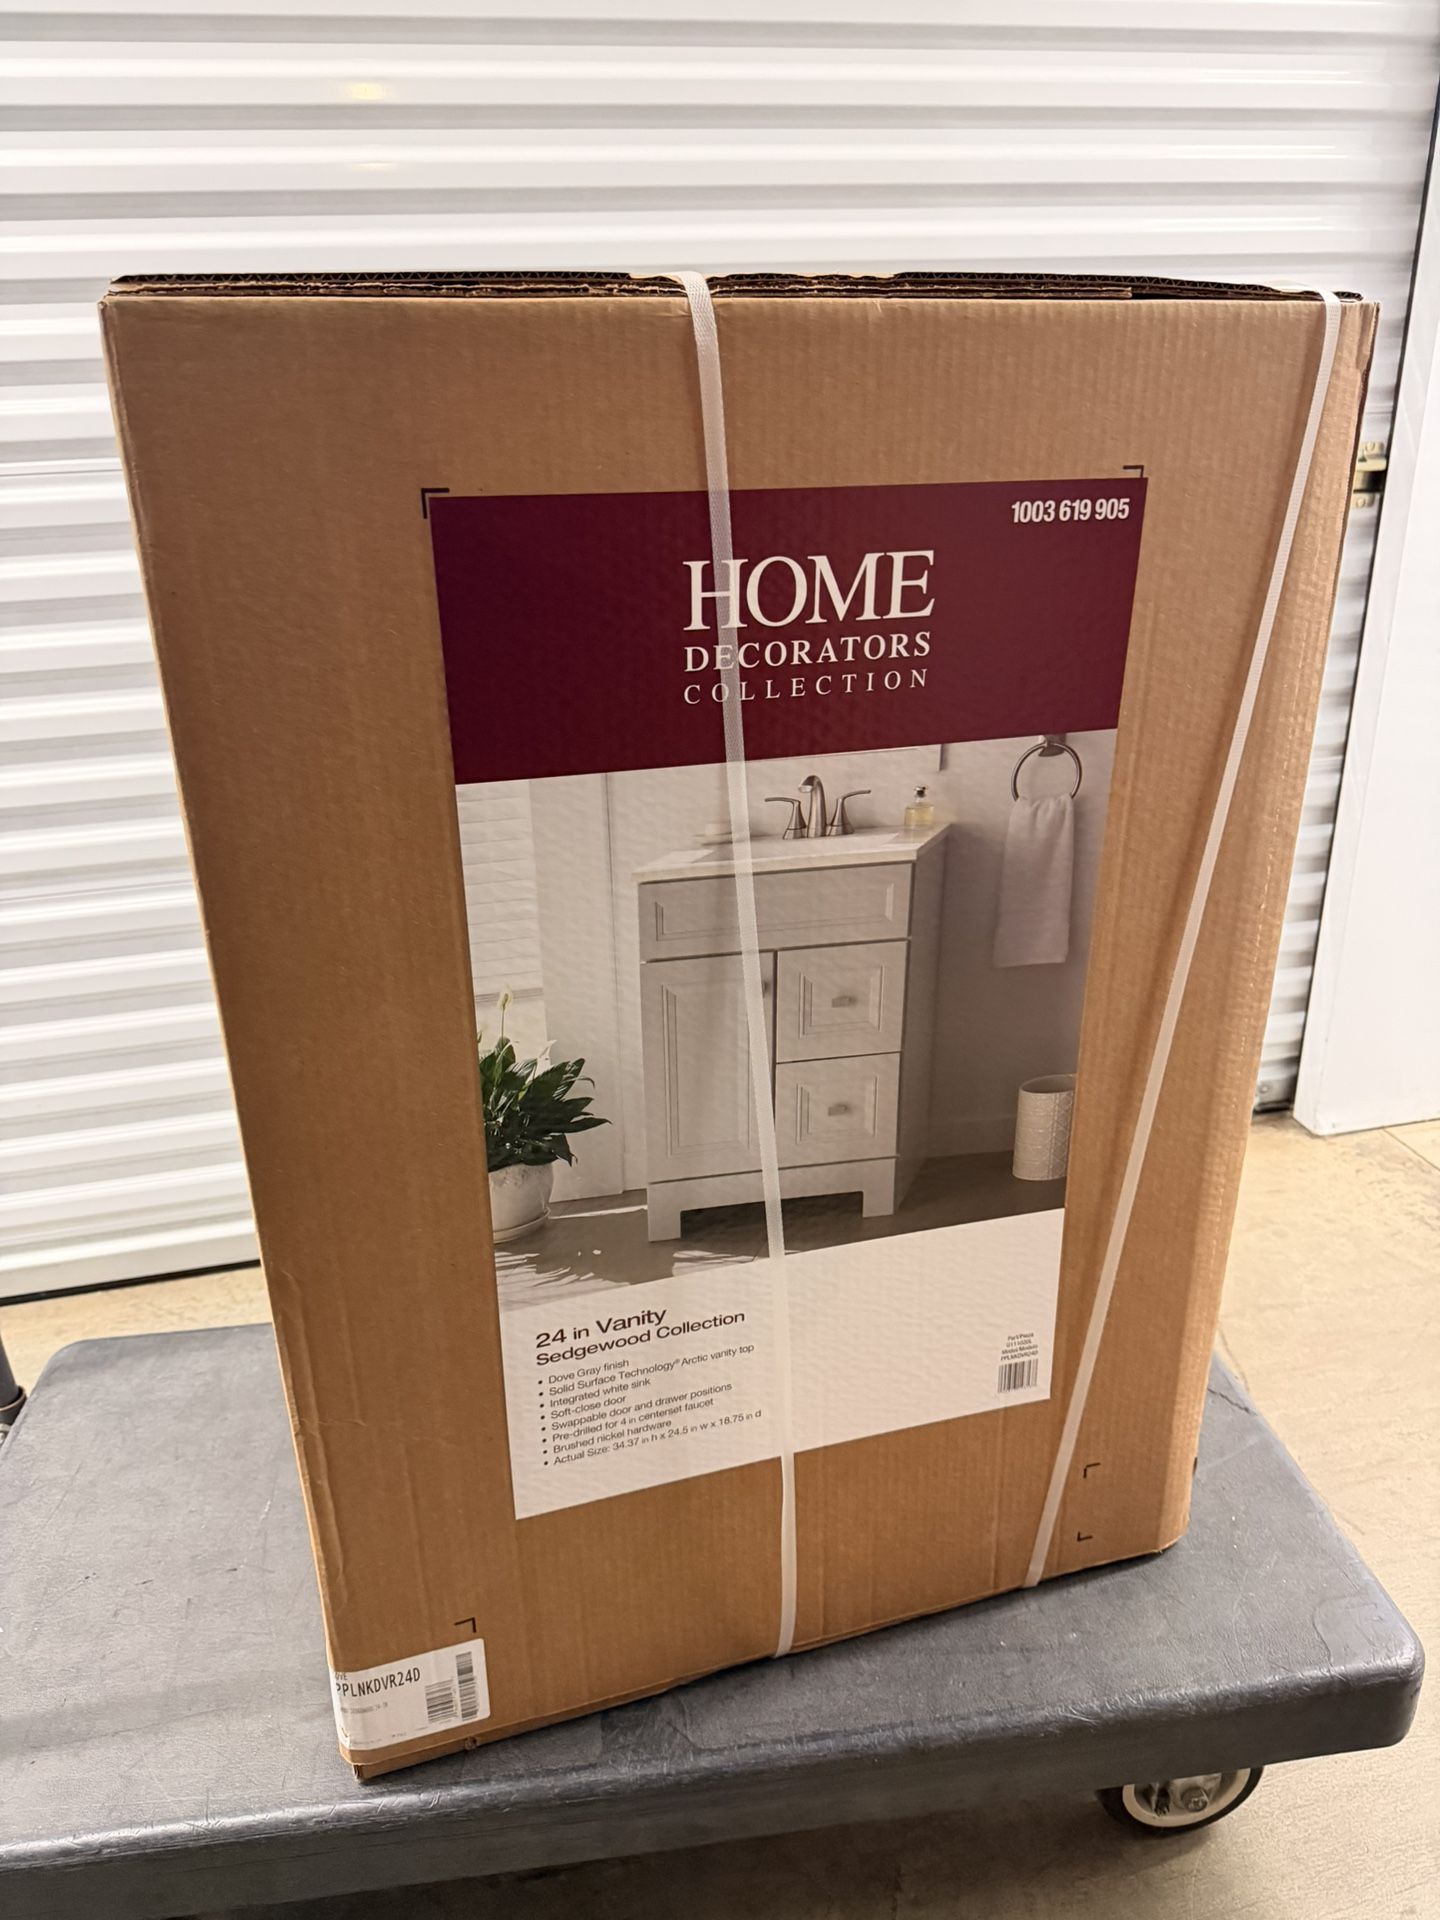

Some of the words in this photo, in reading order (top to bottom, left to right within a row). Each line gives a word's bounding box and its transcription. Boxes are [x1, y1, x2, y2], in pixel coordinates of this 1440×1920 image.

[1011, 500, 1056, 523] 1003
[1059, 499, 1092, 521] 619
[1094, 498, 1130, 520] 905
[682, 550, 936, 631] HOME
[684, 631, 932, 673] DECORATORS
[683, 668, 929, 705] COLLECTION
[535, 1328, 567, 1348] 24
[573, 1327, 590, 1340] in
[596, 1309, 667, 1334] Vanity
[536, 1330, 651, 1366] Sedgewood
[656, 1312, 745, 1339] Collection
[548, 1372, 575, 1384] Dove
[577, 1366, 601, 1378] Gray
[604, 1360, 630, 1371] finish
[549, 1383, 575, 1396] Solid
[577, 1375, 616, 1390] Surface
[681, 1354, 708, 1366] Arctic
[710, 1347, 738, 1360] vanity
[740, 1344, 755, 1354] top
[550, 1389, 601, 1408] Integrated
[602, 1383, 629, 1396] white
[631, 1377, 652, 1388] sink
[551, 1401, 601, 1419] Soft-close
[604, 1395, 627, 1406] door
[552, 1411, 607, 1431] Swappable
[609, 1405, 632, 1417] door
[634, 1400, 653, 1412] and
[655, 1393, 689, 1407] drawer
[690, 1383, 732, 1400] positions
[552, 1424, 603, 1442] Pre-drilled
[604, 1420, 618, 1430] for
[620, 1418, 627, 1426] 4
[628, 1416, 637, 1424] in
[638, 1404, 682, 1422] centerset
[684, 1398, 714, 1411] faucet
[553, 1437, 595, 1454] Brushed
[596, 1429, 625, 1444] nickel
[626, 1420, 672, 1436] hardware
[554, 1452, 585, 1466] Actual
[587, 1445, 611, 1457] Size:
[612, 1436, 640, 1451] 34.37
[641, 1436, 649, 1444] in
[668, 1426, 689, 1438] 24.5
[700, 1423, 709, 1431] w
[719, 1413, 744, 1426] 18.75
[754, 1410, 762, 1418] d
